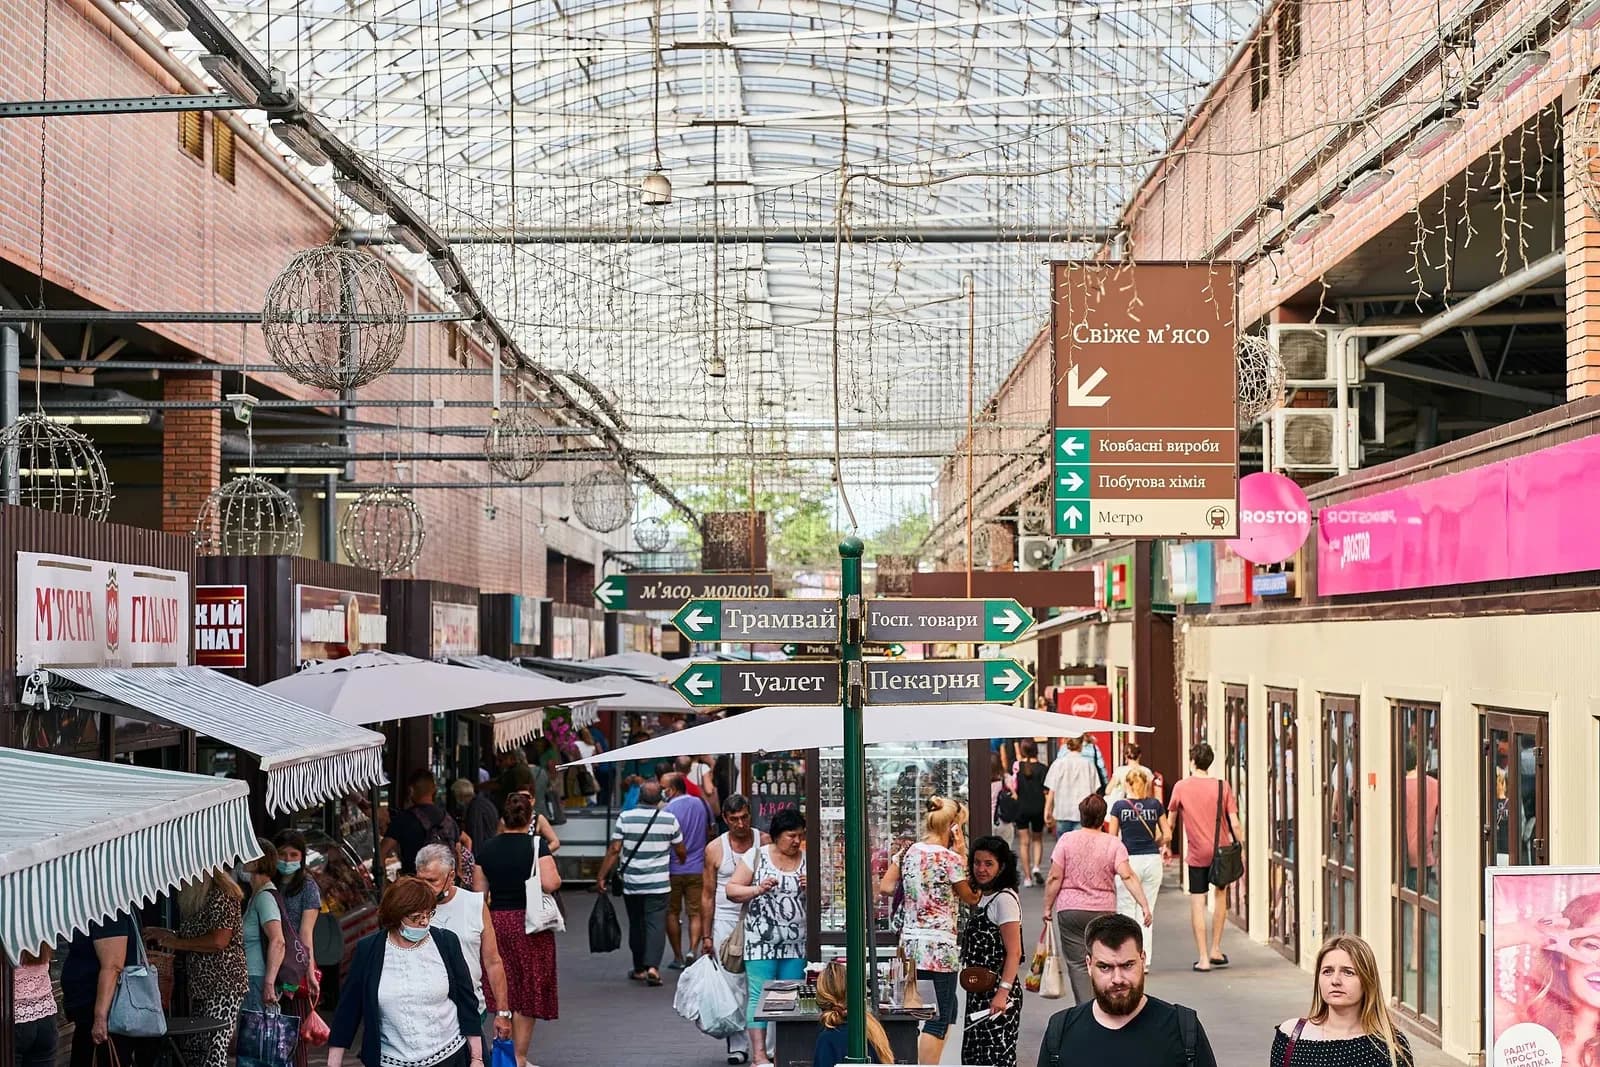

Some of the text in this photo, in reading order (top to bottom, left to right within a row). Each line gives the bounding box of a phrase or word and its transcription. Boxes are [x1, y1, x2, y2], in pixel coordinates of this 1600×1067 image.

[1073, 323, 1210, 344] Свіже м'ясо
[1099, 439, 1220, 455] Ковбасні вироби
[1098, 474, 1206, 491] Побутова хімія
[1098, 511, 1143, 526] Метро
[1239, 510, 1308, 525] ROSTOR
[36, 587, 178, 647] М'ЯСНА ГІЛЬДІЯ
[195, 600, 242, 625] КИЙ
[725, 608, 837, 633] Трамвай
[871, 612, 978, 631] Госп. товари
[739, 672, 825, 697] Туалет
[870, 671, 980, 695] Пекарня
[1503, 1041, 1537, 1057] РАДІТИ
[1505, 1048, 1548, 1065] ПРОСТО.
